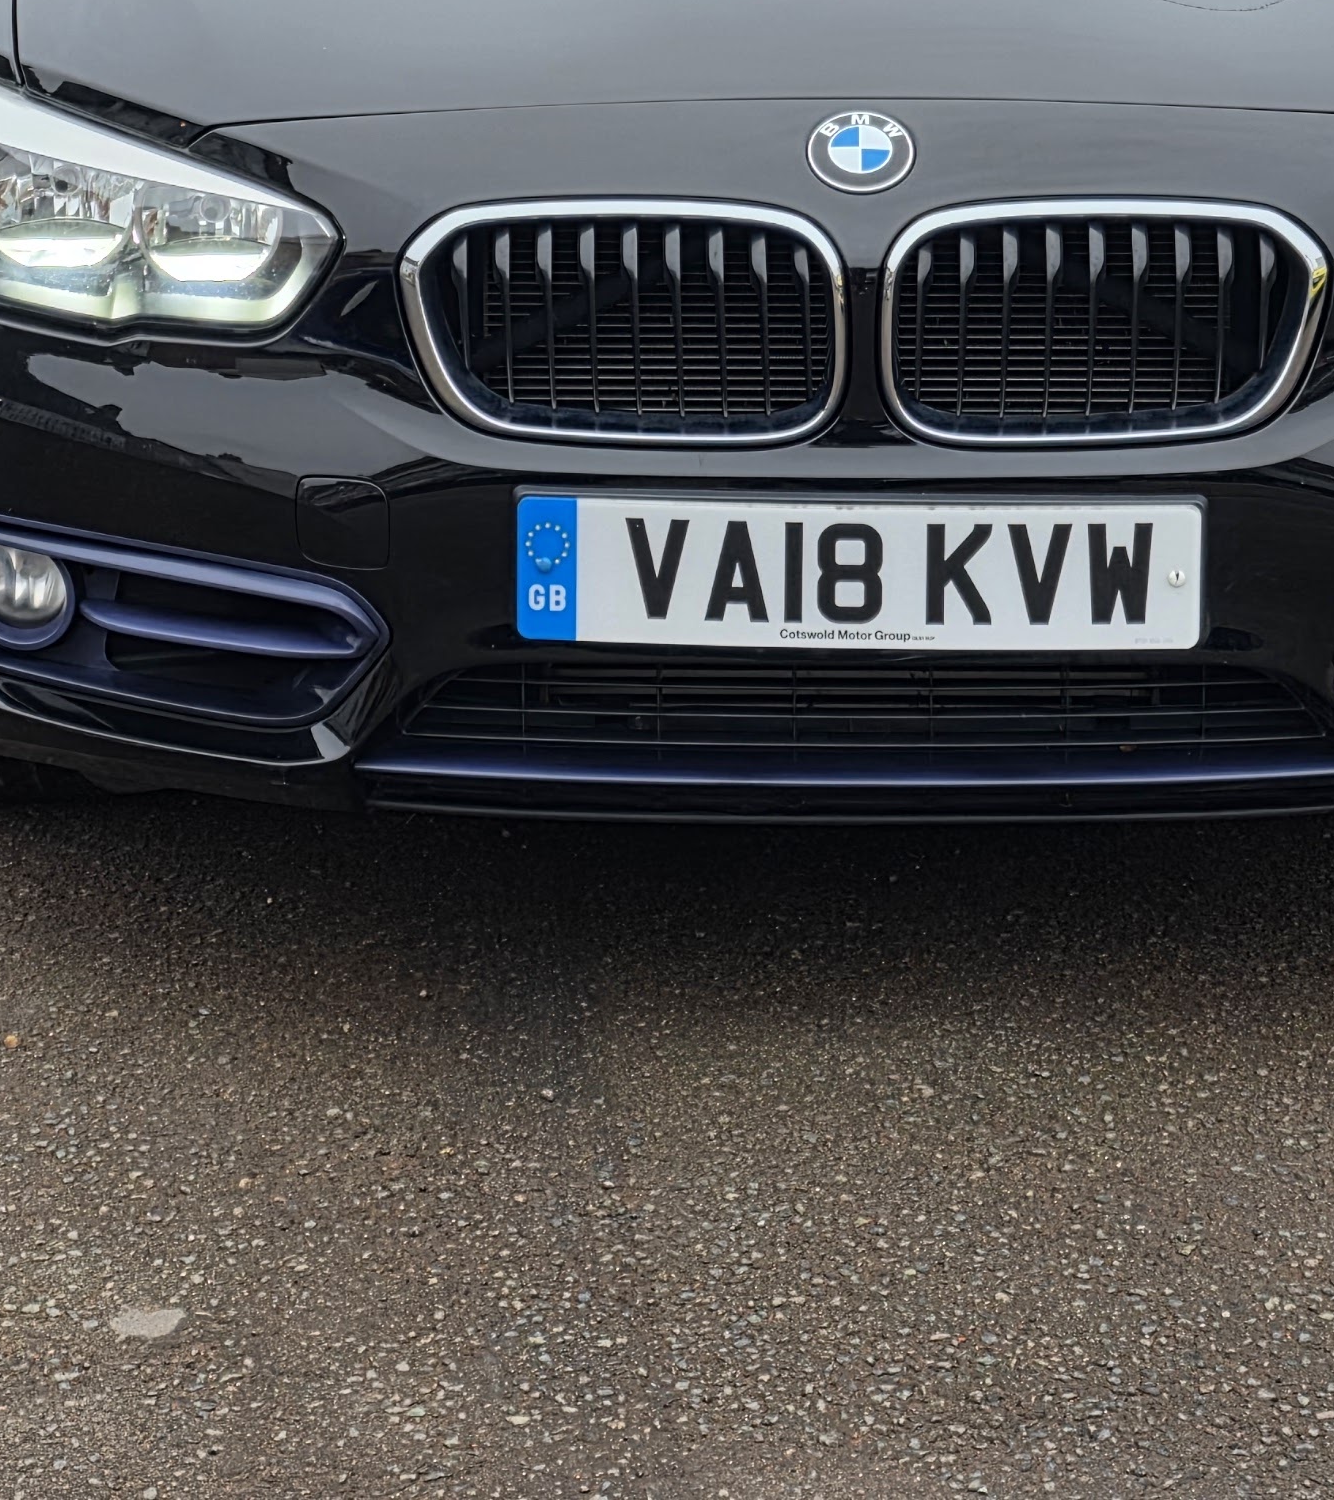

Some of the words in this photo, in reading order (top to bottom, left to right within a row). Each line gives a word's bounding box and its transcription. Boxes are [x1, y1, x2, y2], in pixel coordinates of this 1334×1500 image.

[820, 113, 903, 138] BMW
[625, 517, 883, 624] VA18
[925, 522, 1154, 625] KVW
[528, 583, 567, 612] GB
[779, 629, 835, 640] Cotswold
[837, 630, 873, 640] Motor
[874, 631, 911, 642] Group
